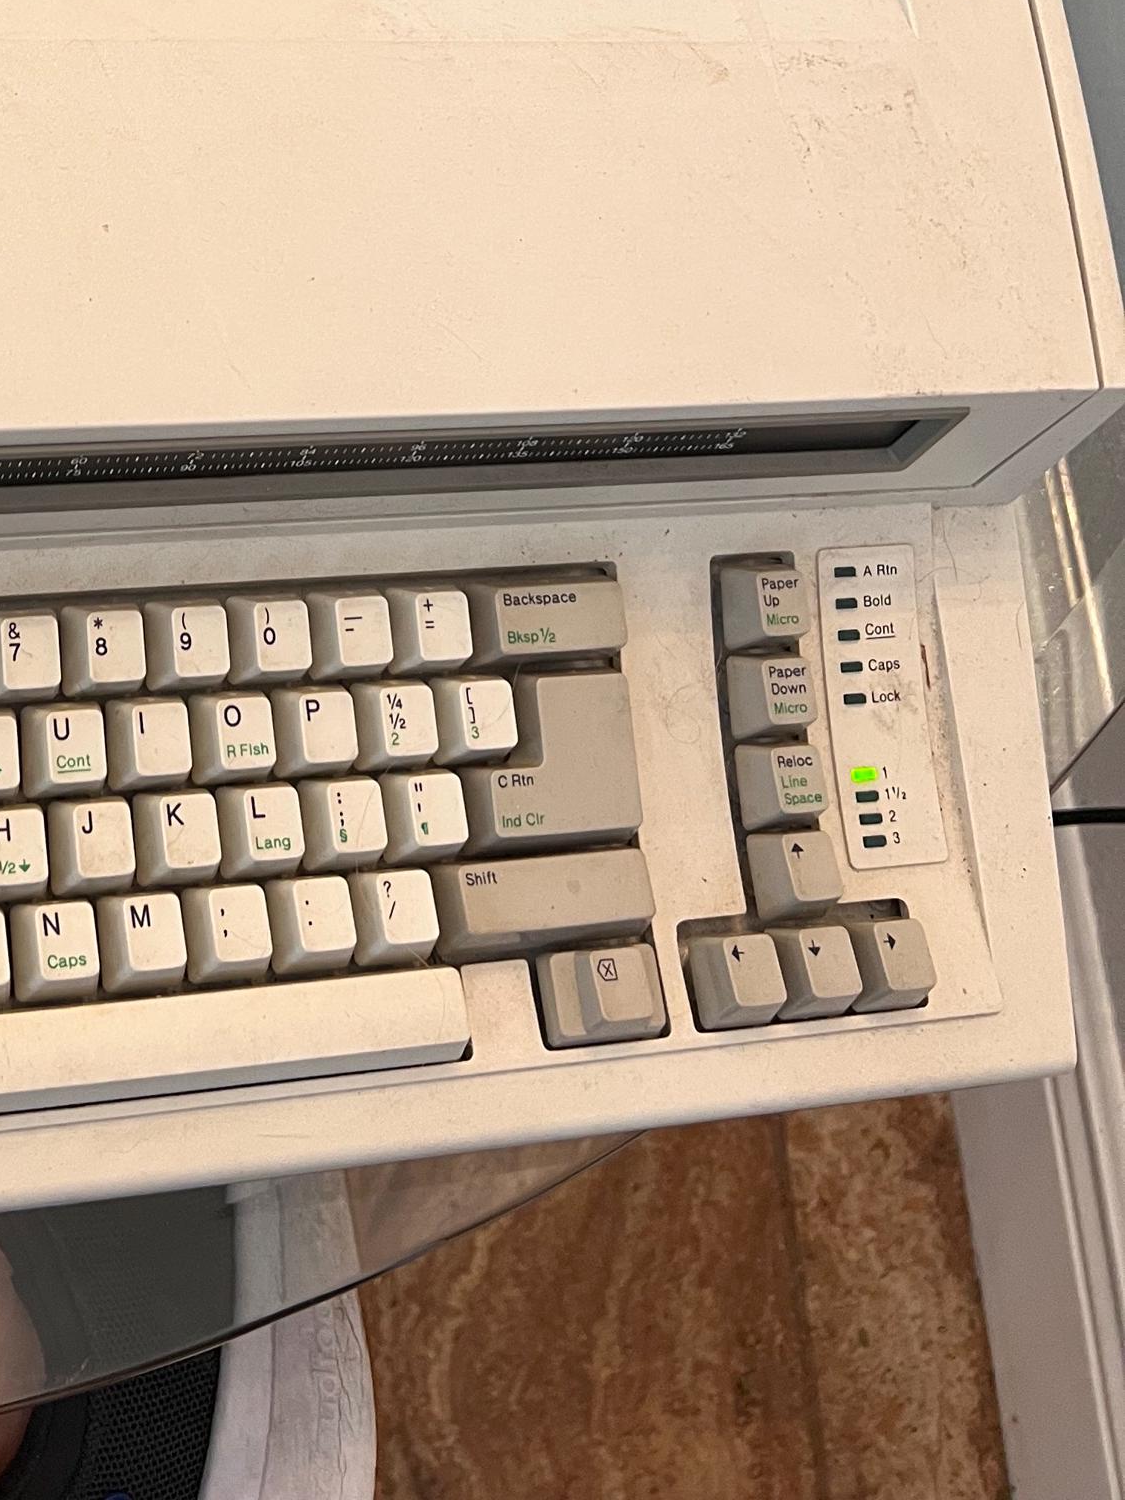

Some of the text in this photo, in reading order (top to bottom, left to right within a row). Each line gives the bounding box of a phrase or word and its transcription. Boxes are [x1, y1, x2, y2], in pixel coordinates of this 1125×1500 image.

[863, 565, 897, 576] A Rtn
[762, 578, 799, 590] Paper
[423, 599, 433, 611] +
[503, 591, 576, 606] Backspace
[764, 596, 779, 607] Up
[863, 596, 891, 606] Bold
[767, 614, 799, 625] Micro
[8, 622, 20, 639] &
[865, 624, 895, 636] Cont
[180, 633, 191, 650] 9
[507, 630, 540, 645] Bksp
[9, 643, 20, 661] 7
[95, 637, 107, 656] 8
[769, 666, 807, 678] Paper
[869, 659, 900, 671] Caps
[771, 683, 807, 695] Down
[872, 691, 901, 702] Lock
[306, 700, 320, 721] P
[775, 702, 807, 714] Micro
[138, 712, 145, 733] I
[224, 705, 241, 727] O
[53, 718, 70, 741] U
[471, 726, 479, 738] 3
[391, 733, 399, 746] 2
[227, 745, 235, 758] R
[56, 754, 91, 769] Cont
[777, 755, 813, 768] Reloc
[498, 773, 534, 787] C Rtn
[883, 768, 887, 778] 1
[781, 775, 807, 788] Line
[785, 792, 822, 805] Space
[167, 804, 184, 825] K
[251, 797, 265, 818] L
[82, 811, 94, 834] J
[502, 813, 544, 828] Ind Clr
[889, 810, 897, 822] 2
[255, 835, 291, 851] Lang
[893, 832, 900, 844] 3
[466, 871, 497, 886] Shift
[384, 880, 391, 897] ?
[130, 905, 151, 928] M
[389, 901, 396, 919] /
[42, 913, 60, 936] N
[47, 953, 87, 970] Caps
